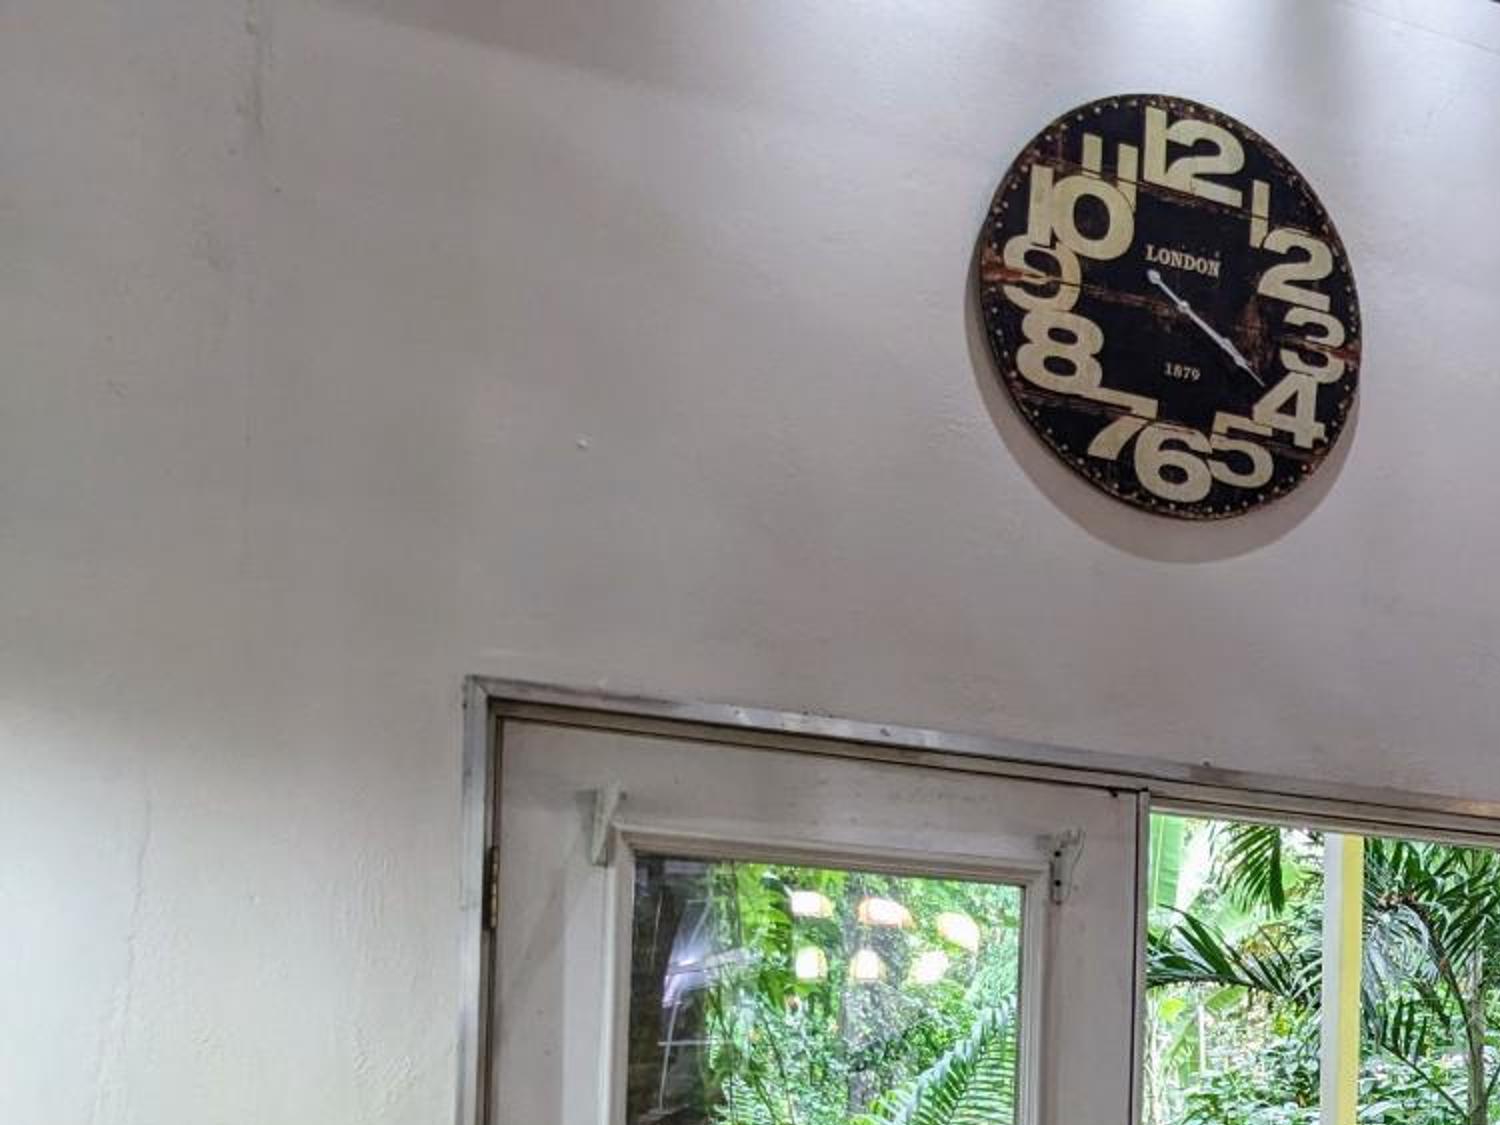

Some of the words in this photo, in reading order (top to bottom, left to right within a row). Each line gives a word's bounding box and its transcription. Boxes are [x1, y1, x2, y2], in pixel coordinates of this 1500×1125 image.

[1143, 105, 1244, 206] 12
[1028, 163, 1136, 260] 10
[1252, 181, 1270, 247] 1
[1003, 233, 1083, 312] 9
[1144, 244, 1221, 277] LONDON
[1257, 227, 1334, 308] 2
[1016, 305, 1104, 396] 8
[1164, 362, 1201, 382] 1879
[1279, 306, 1346, 383] 3
[1086, 388, 1158, 461] 7
[1208, 410, 1273, 489] 5
[1252, 372, 1326, 449] 4
[1134, 422, 1213, 504] 6
